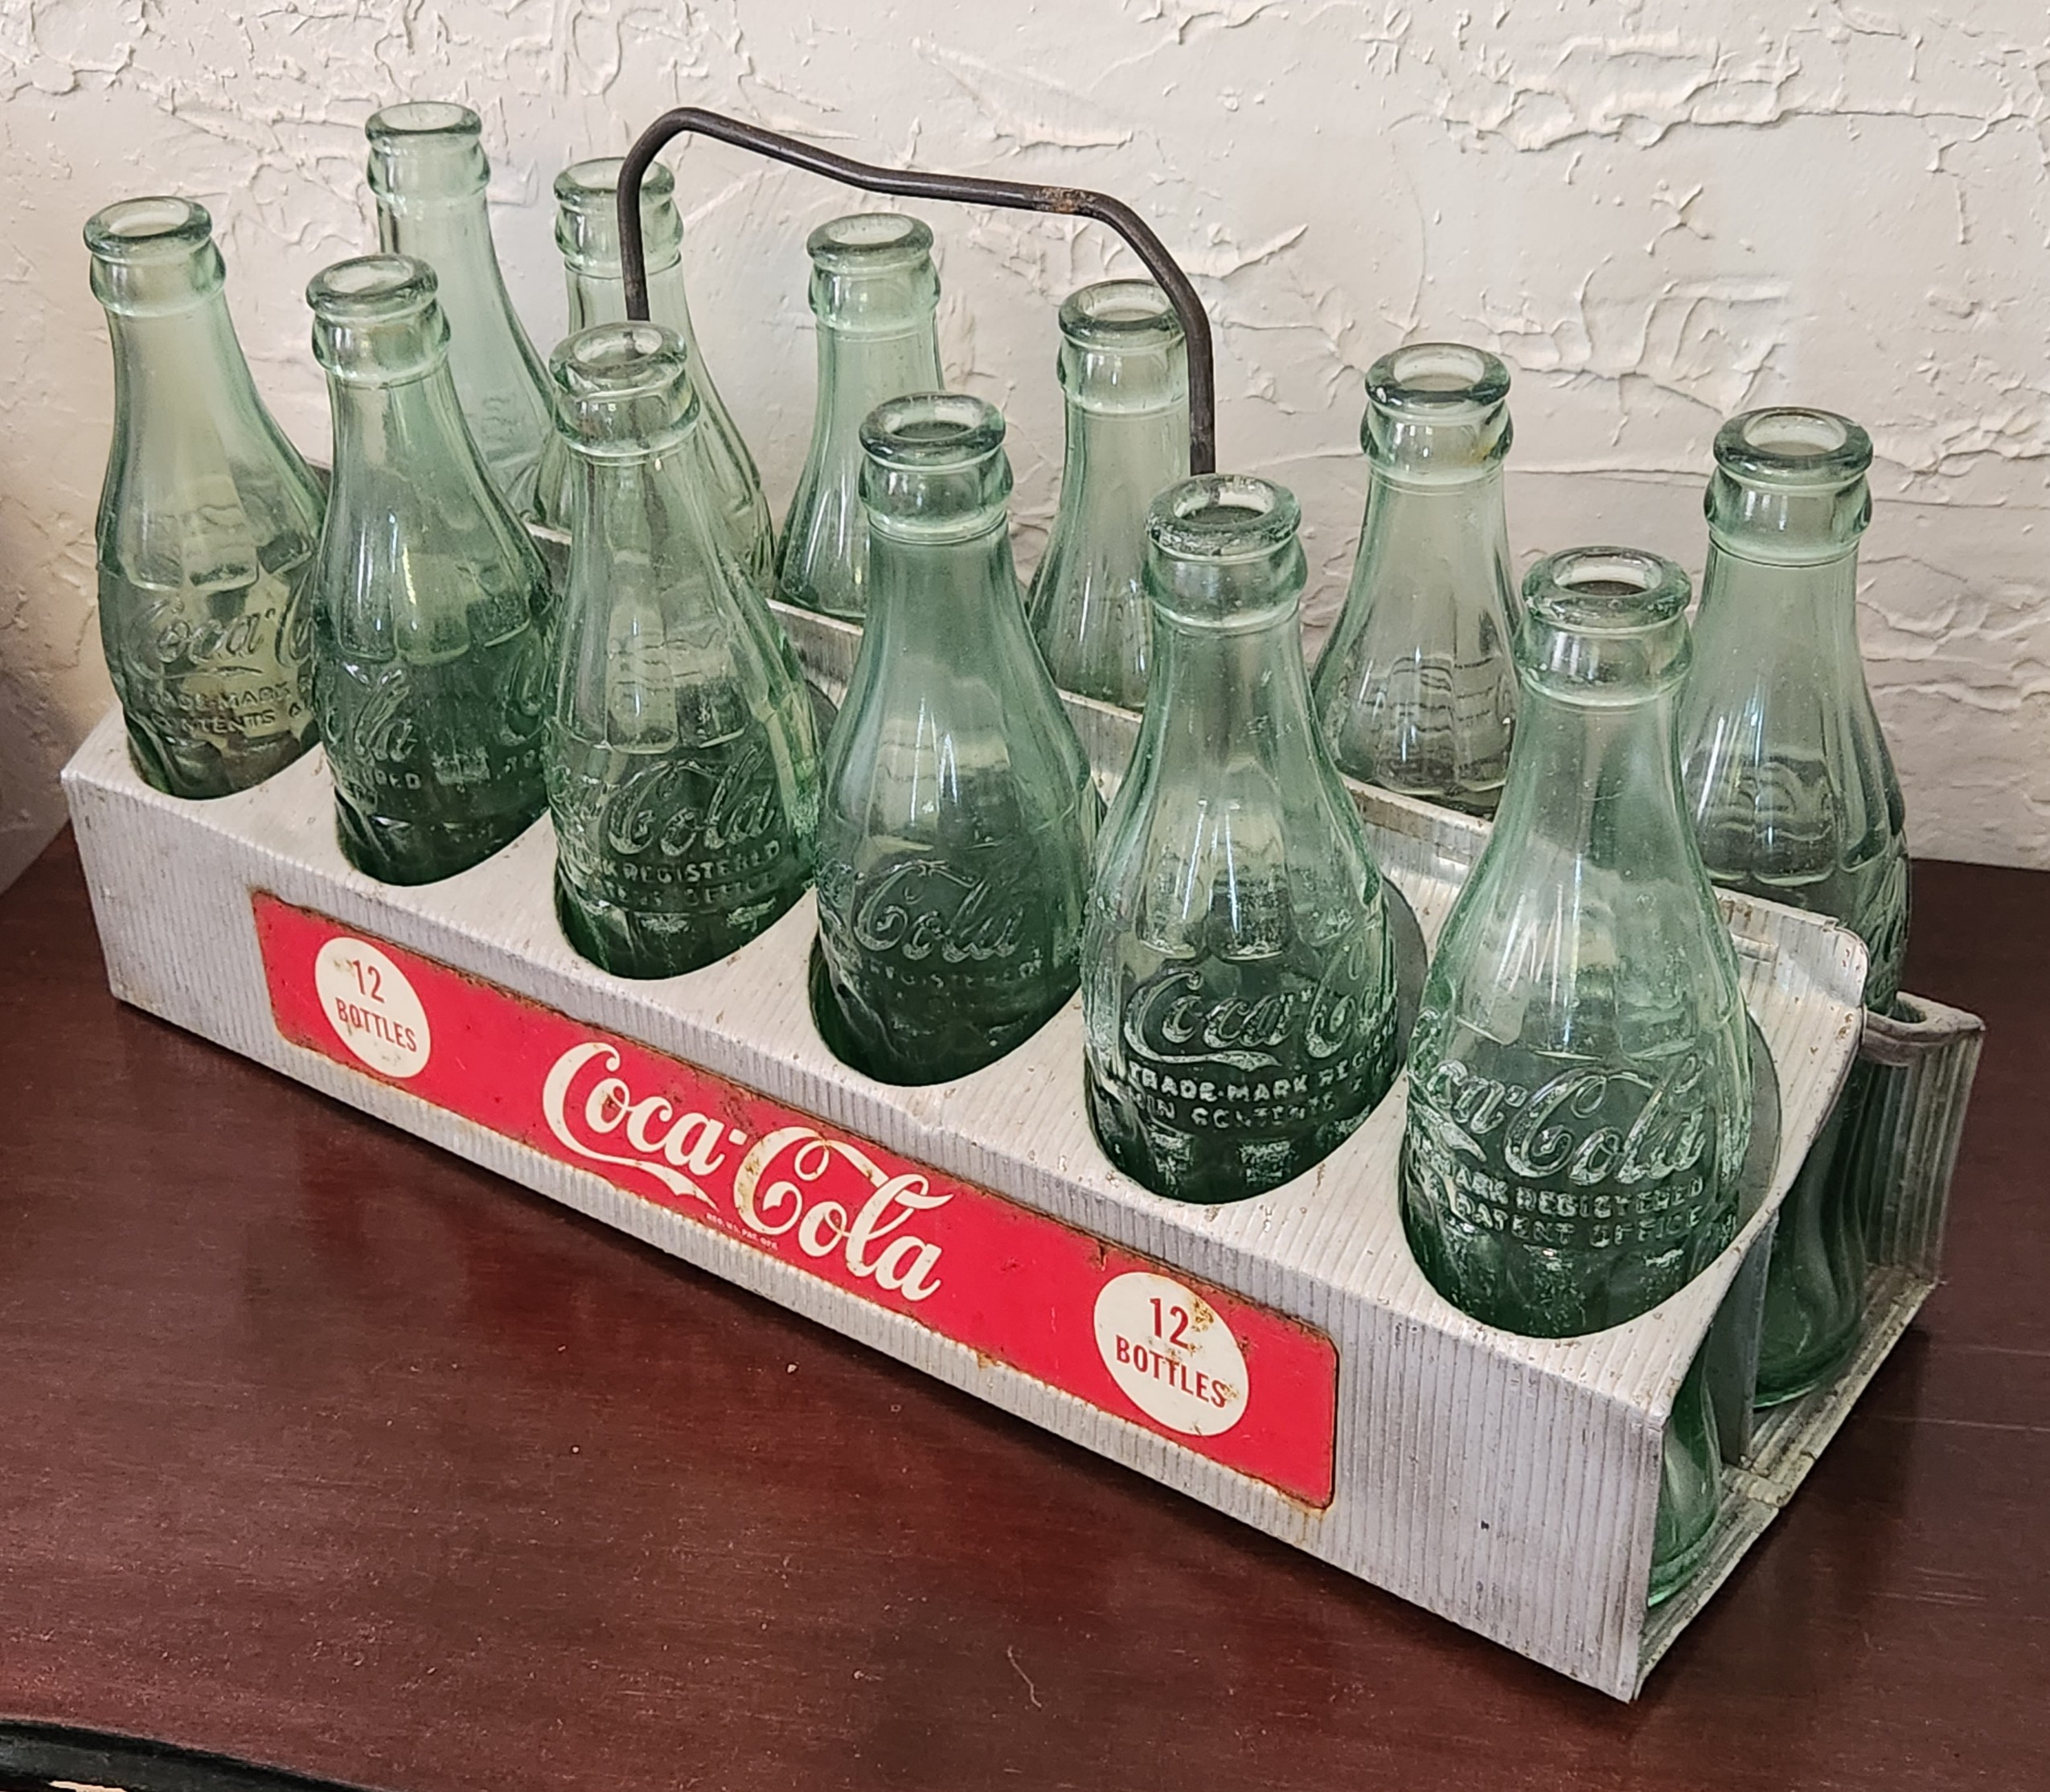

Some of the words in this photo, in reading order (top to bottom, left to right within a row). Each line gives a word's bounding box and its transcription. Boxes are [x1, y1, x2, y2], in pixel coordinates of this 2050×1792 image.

[351, 959, 386, 1004] 12
[334, 997, 417, 1053] BOTTLES
[542, 1041, 955, 1302] Coca-Cola
[1149, 1297, 1190, 1349] 12
[1115, 1333, 1228, 1409] BOTTLES
